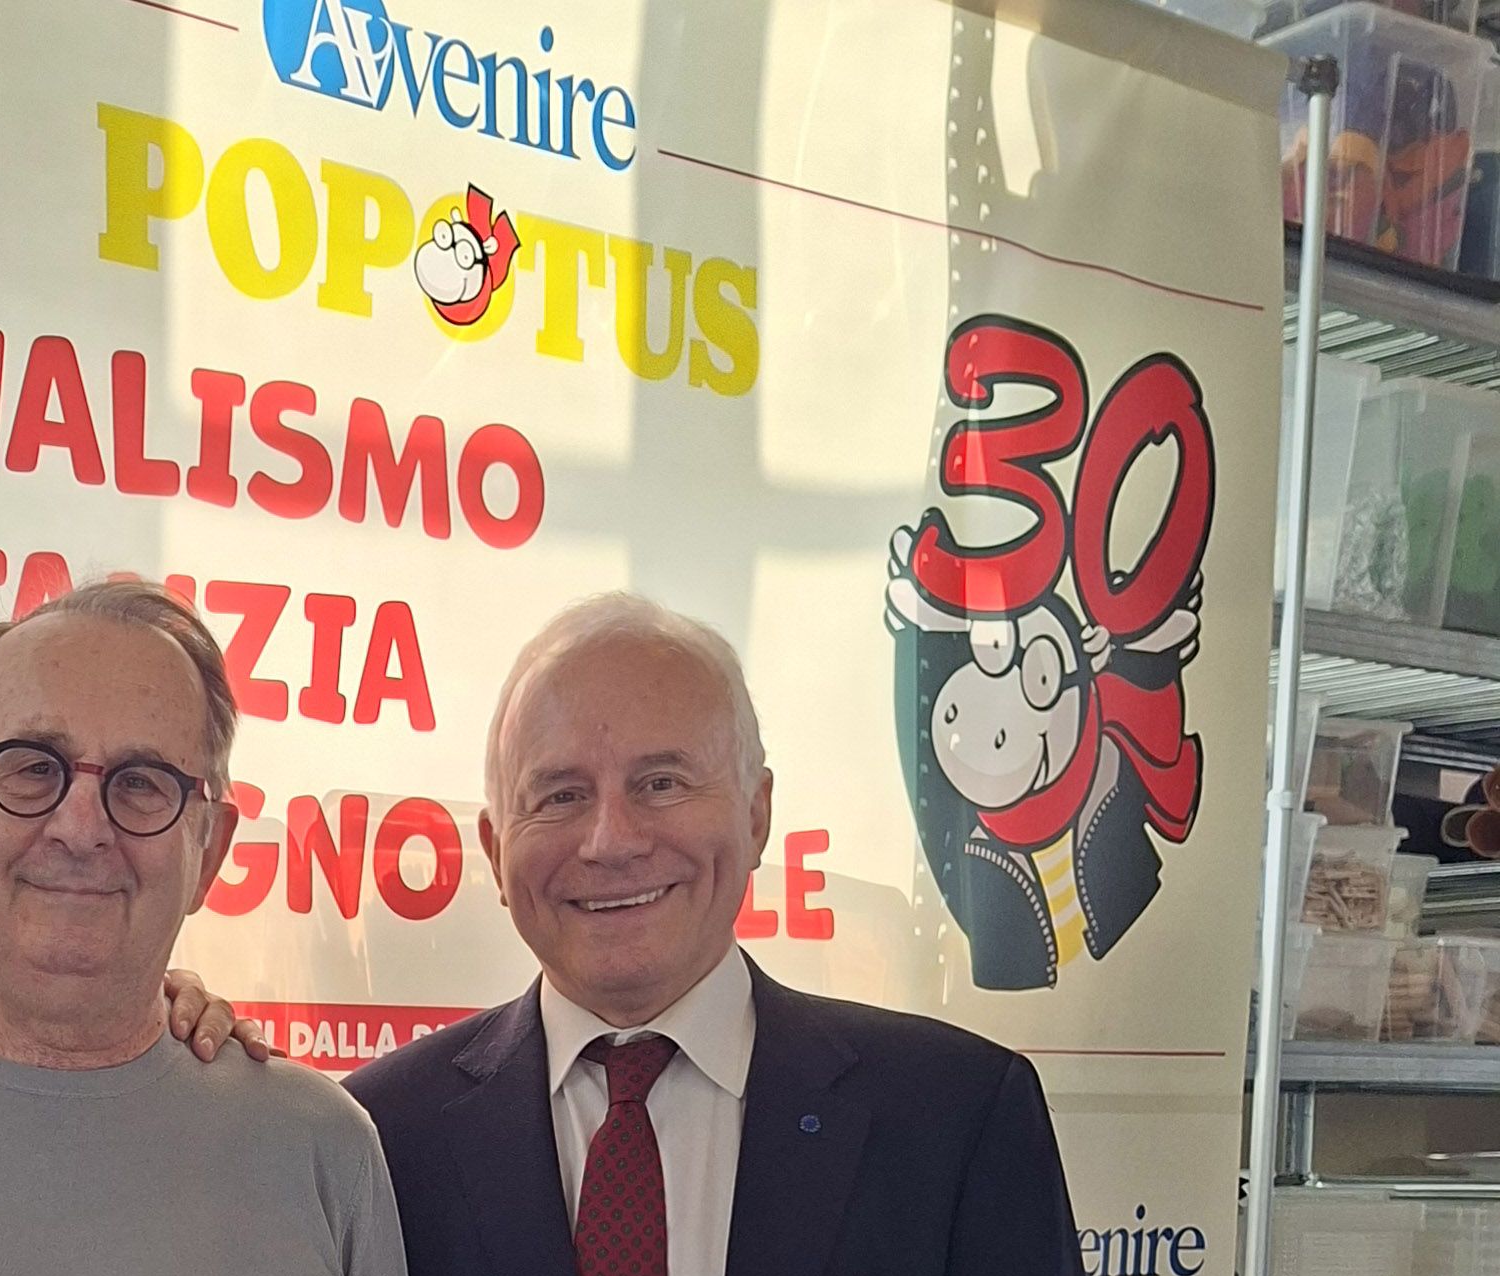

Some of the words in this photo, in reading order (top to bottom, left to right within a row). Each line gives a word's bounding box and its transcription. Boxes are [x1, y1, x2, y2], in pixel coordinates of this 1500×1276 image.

[288, 0, 637, 171] Avvenire
[911, 313, 1216, 638] 30
[289, 1020, 398, 1059] DALLA
